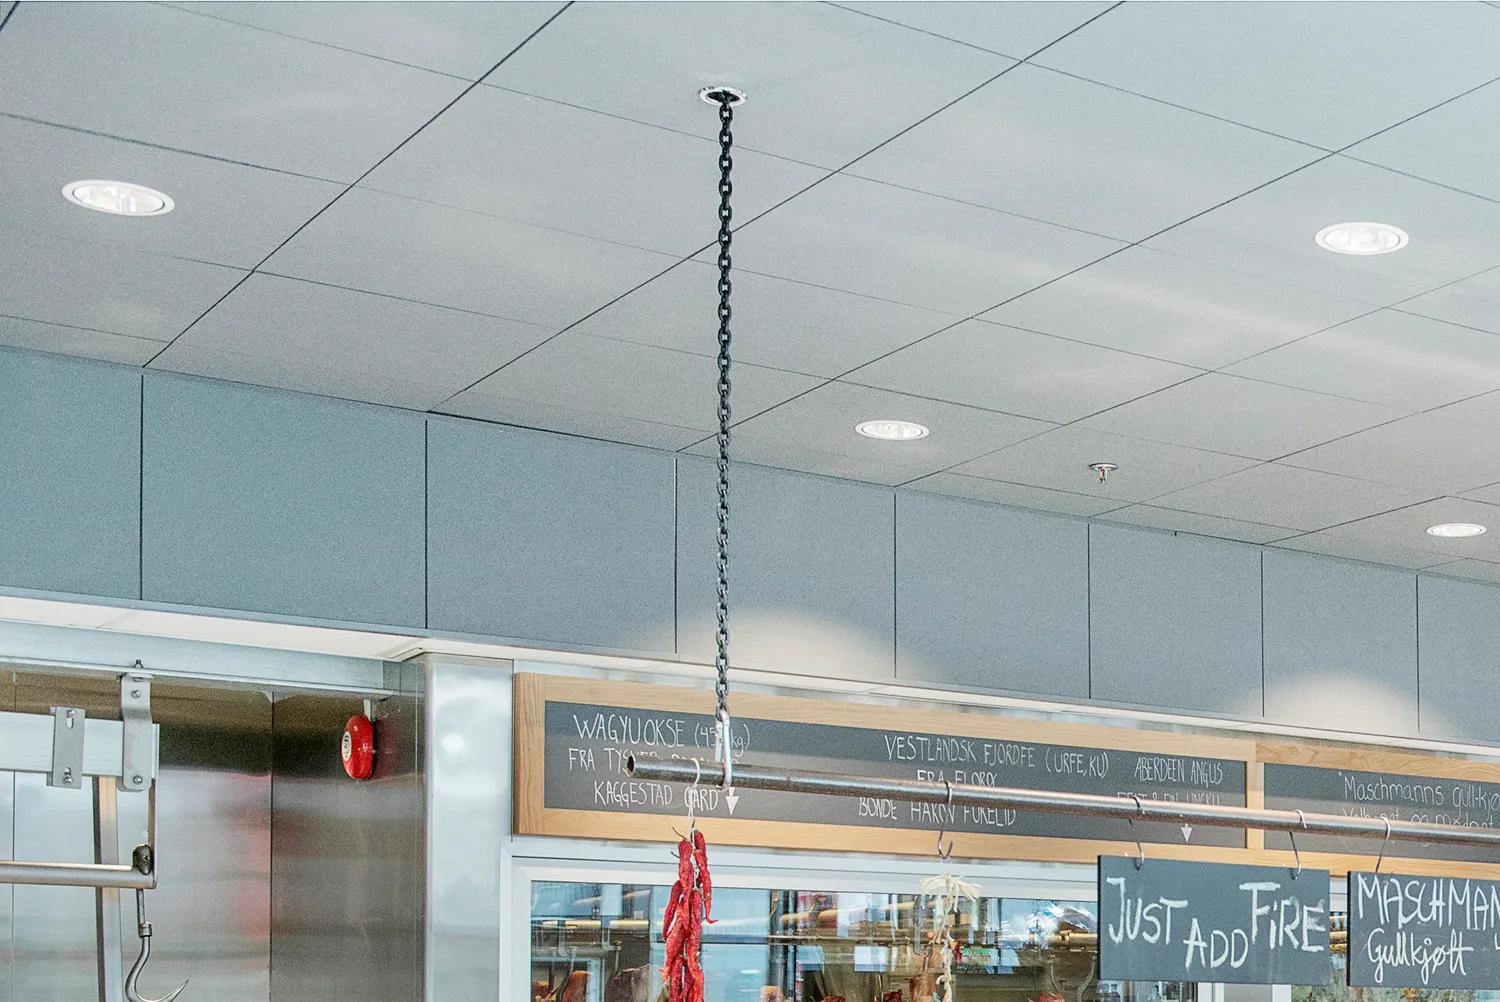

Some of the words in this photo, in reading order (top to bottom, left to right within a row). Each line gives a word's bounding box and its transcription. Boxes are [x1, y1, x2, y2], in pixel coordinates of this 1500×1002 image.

[569, 748, 595, 771] FRA
[884, 734, 977, 762] VESTLANDSK
[1134, 756, 1185, 782] ABERDEEN
[1190, 762, 1223, 788] ANGUS
[594, 780, 673, 809] KAGGESTAD
[859, 797, 898, 820] BONDE
[1106, 876, 1188, 946] JUST
[1182, 917, 1249, 969] ADD
